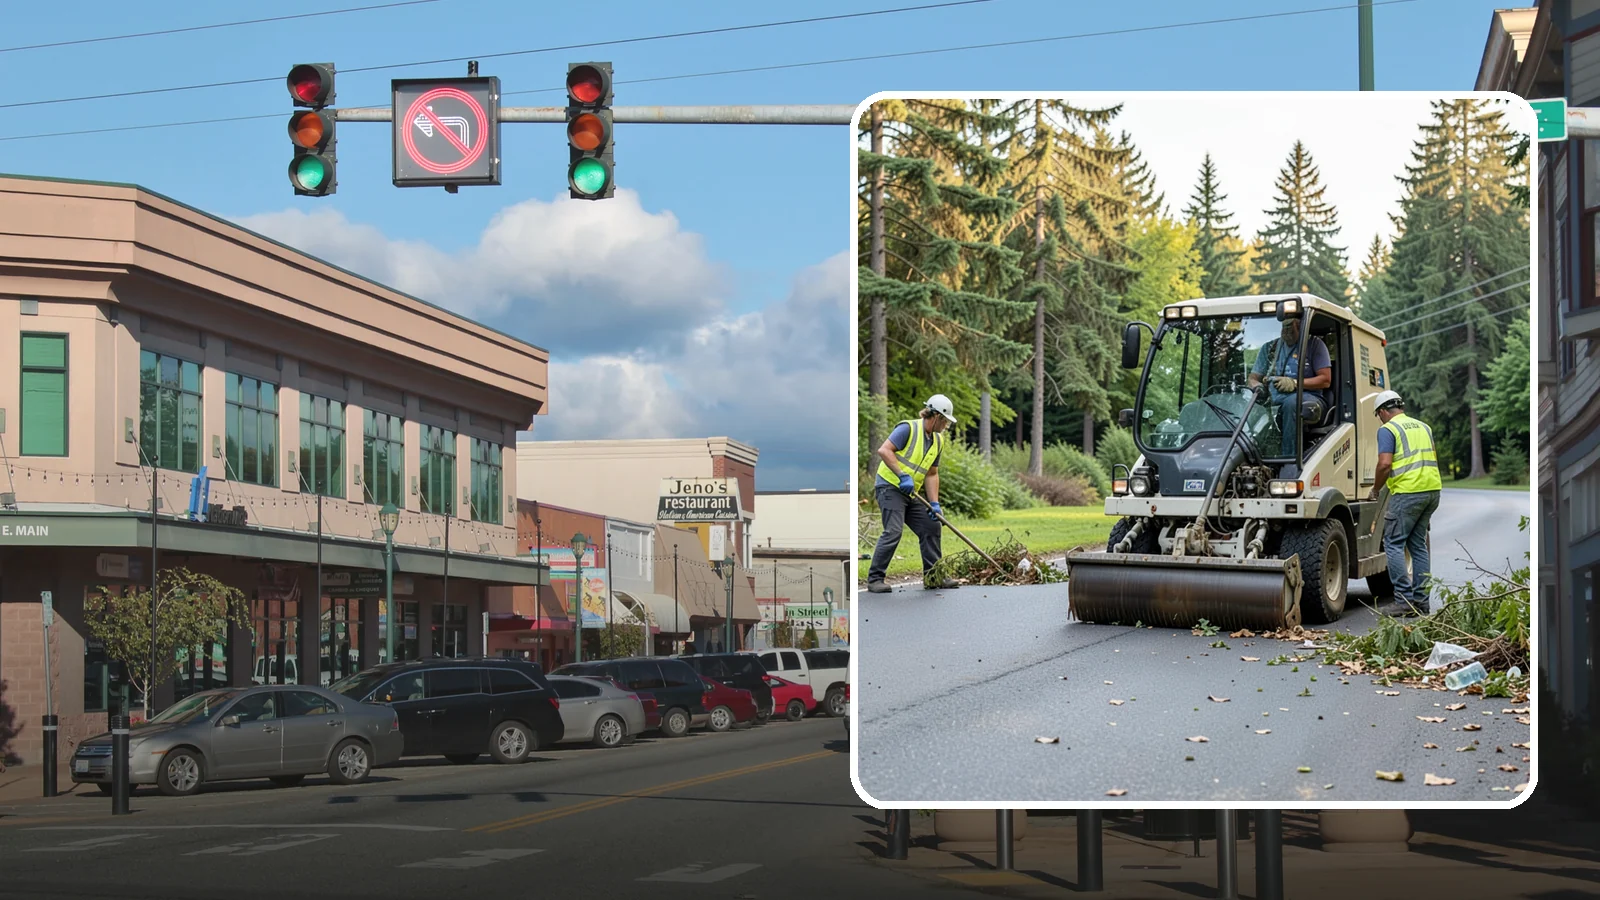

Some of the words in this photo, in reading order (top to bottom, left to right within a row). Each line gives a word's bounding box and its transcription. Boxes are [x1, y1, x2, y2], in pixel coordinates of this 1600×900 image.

[670, 480, 727, 494] Jeno's
[665, 496, 731, 509] restaurant
[659, 510, 681, 519] Italian
[686, 509, 715, 519] American
[715, 510, 738, 519] Cuisine
[2, 525, 13, 536] E.
[15, 525, 49, 536] MAIN
[797, 607, 828, 617] Street
